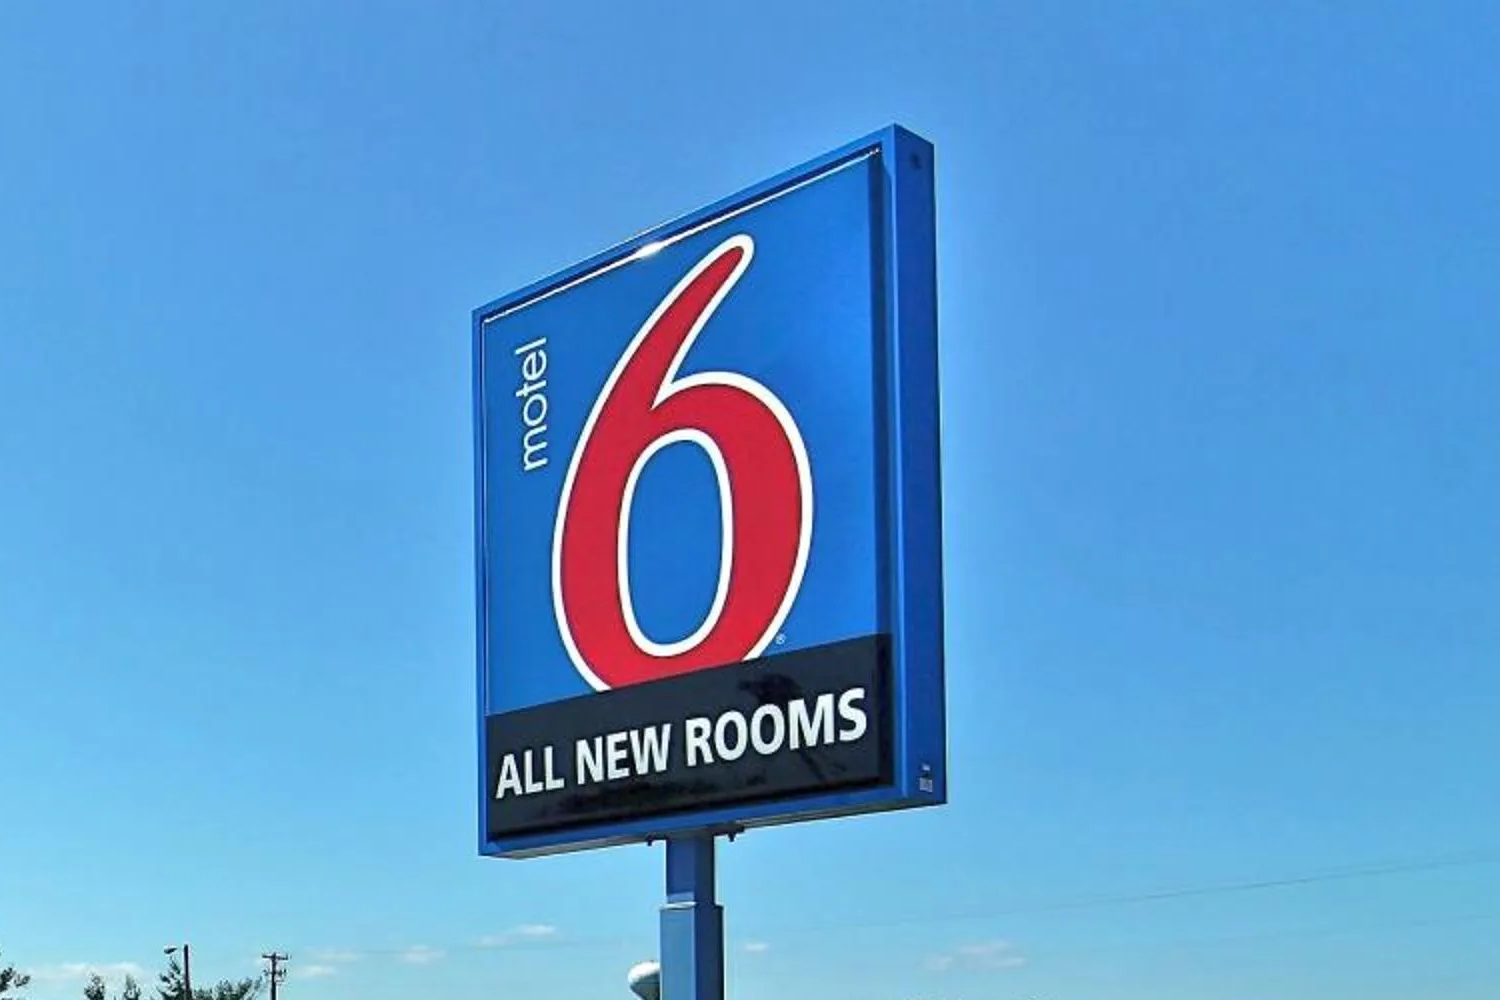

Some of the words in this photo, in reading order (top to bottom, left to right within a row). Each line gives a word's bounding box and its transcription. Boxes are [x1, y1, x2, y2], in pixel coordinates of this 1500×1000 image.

[515, 337, 548, 471] motel
[551, 233, 814, 691] 6
[495, 746, 565, 799] ALL
[576, 723, 671, 785] NEW
[685, 687, 867, 767] ROOMS
